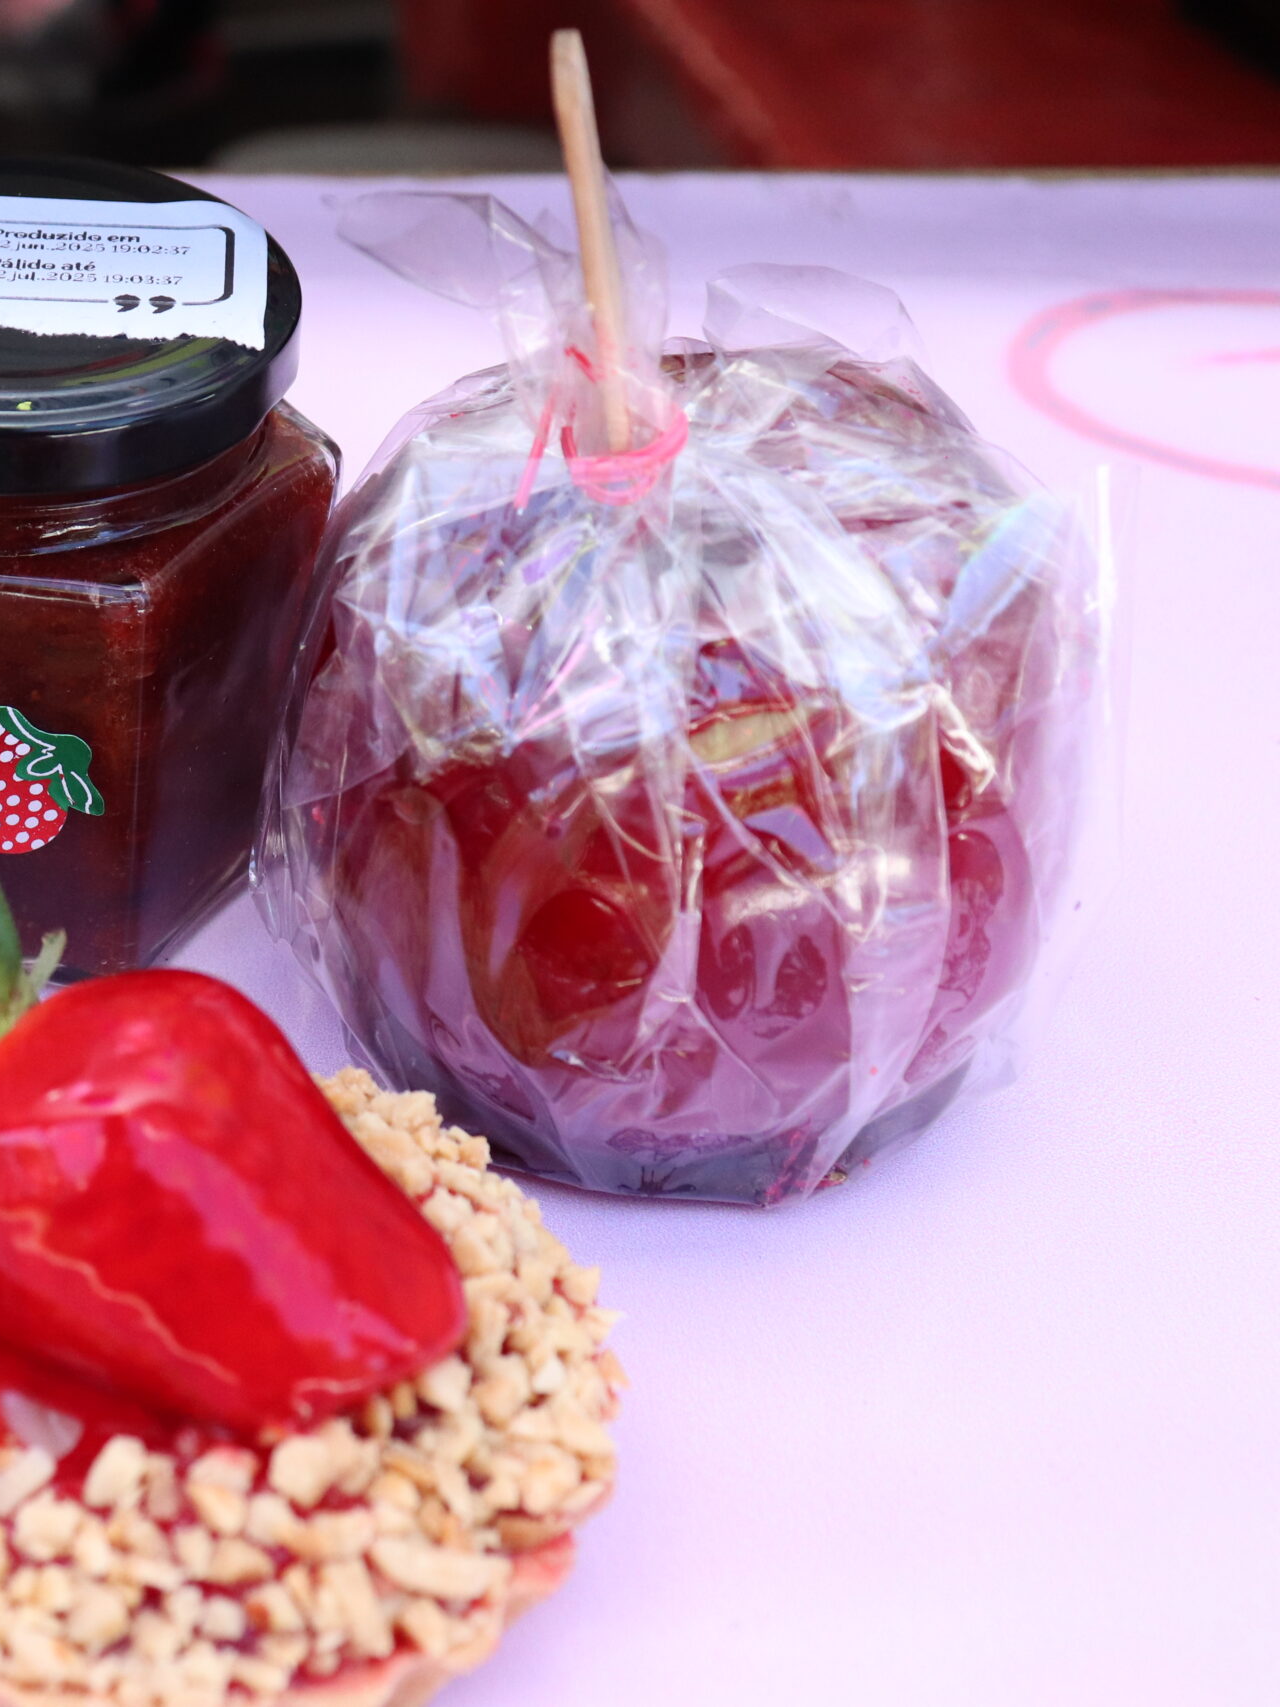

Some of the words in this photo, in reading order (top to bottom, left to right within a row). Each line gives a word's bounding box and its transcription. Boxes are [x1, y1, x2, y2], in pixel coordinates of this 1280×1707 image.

[107, 234, 140, 243] em
[112, 244, 191, 255] 19:02:37
[61, 261, 96, 271] até
[104, 274, 183, 285] 19:03:37
